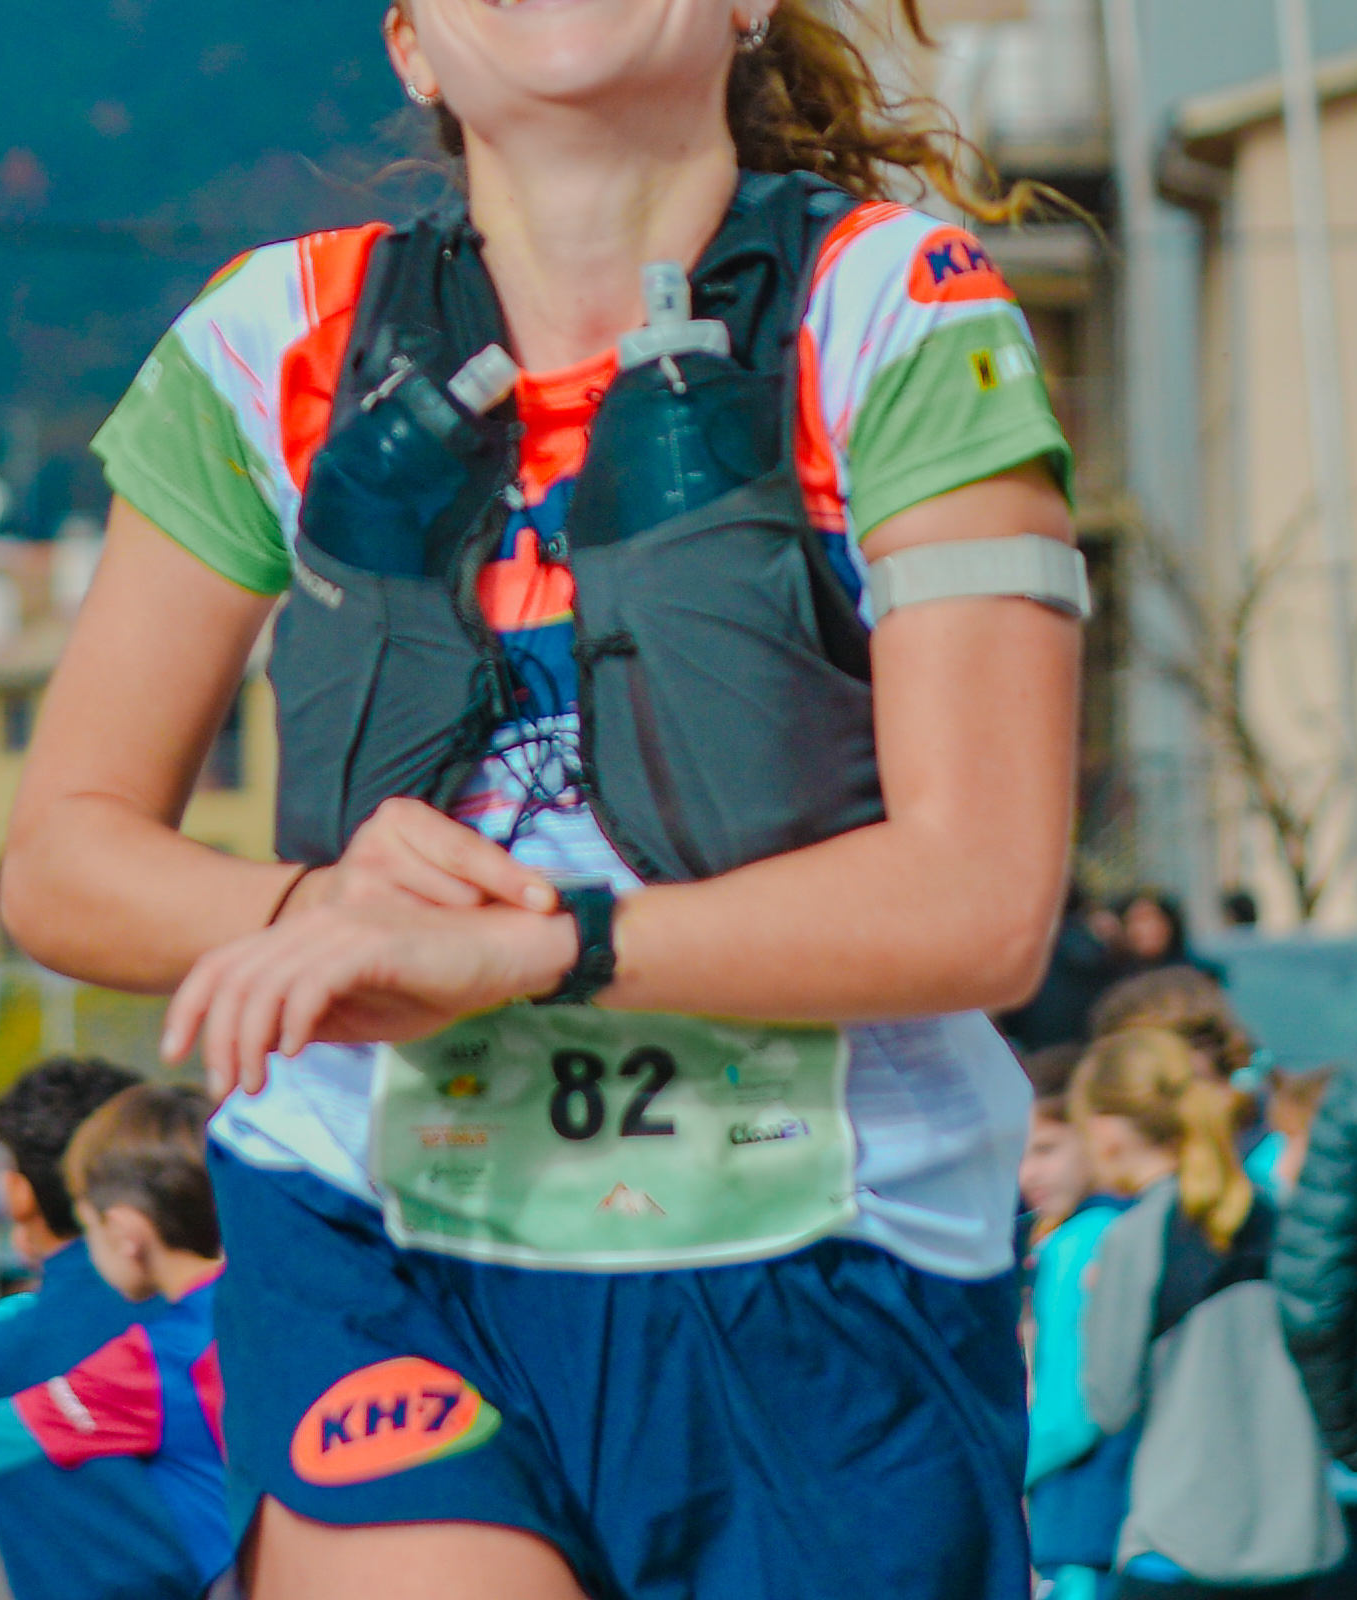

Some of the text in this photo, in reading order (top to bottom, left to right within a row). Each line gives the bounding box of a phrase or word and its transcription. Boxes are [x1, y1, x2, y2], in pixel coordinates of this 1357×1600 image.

[925, 241, 996, 285] KH
[549, 1043, 677, 1141] 82
[319, 1390, 461, 1454] KH7
